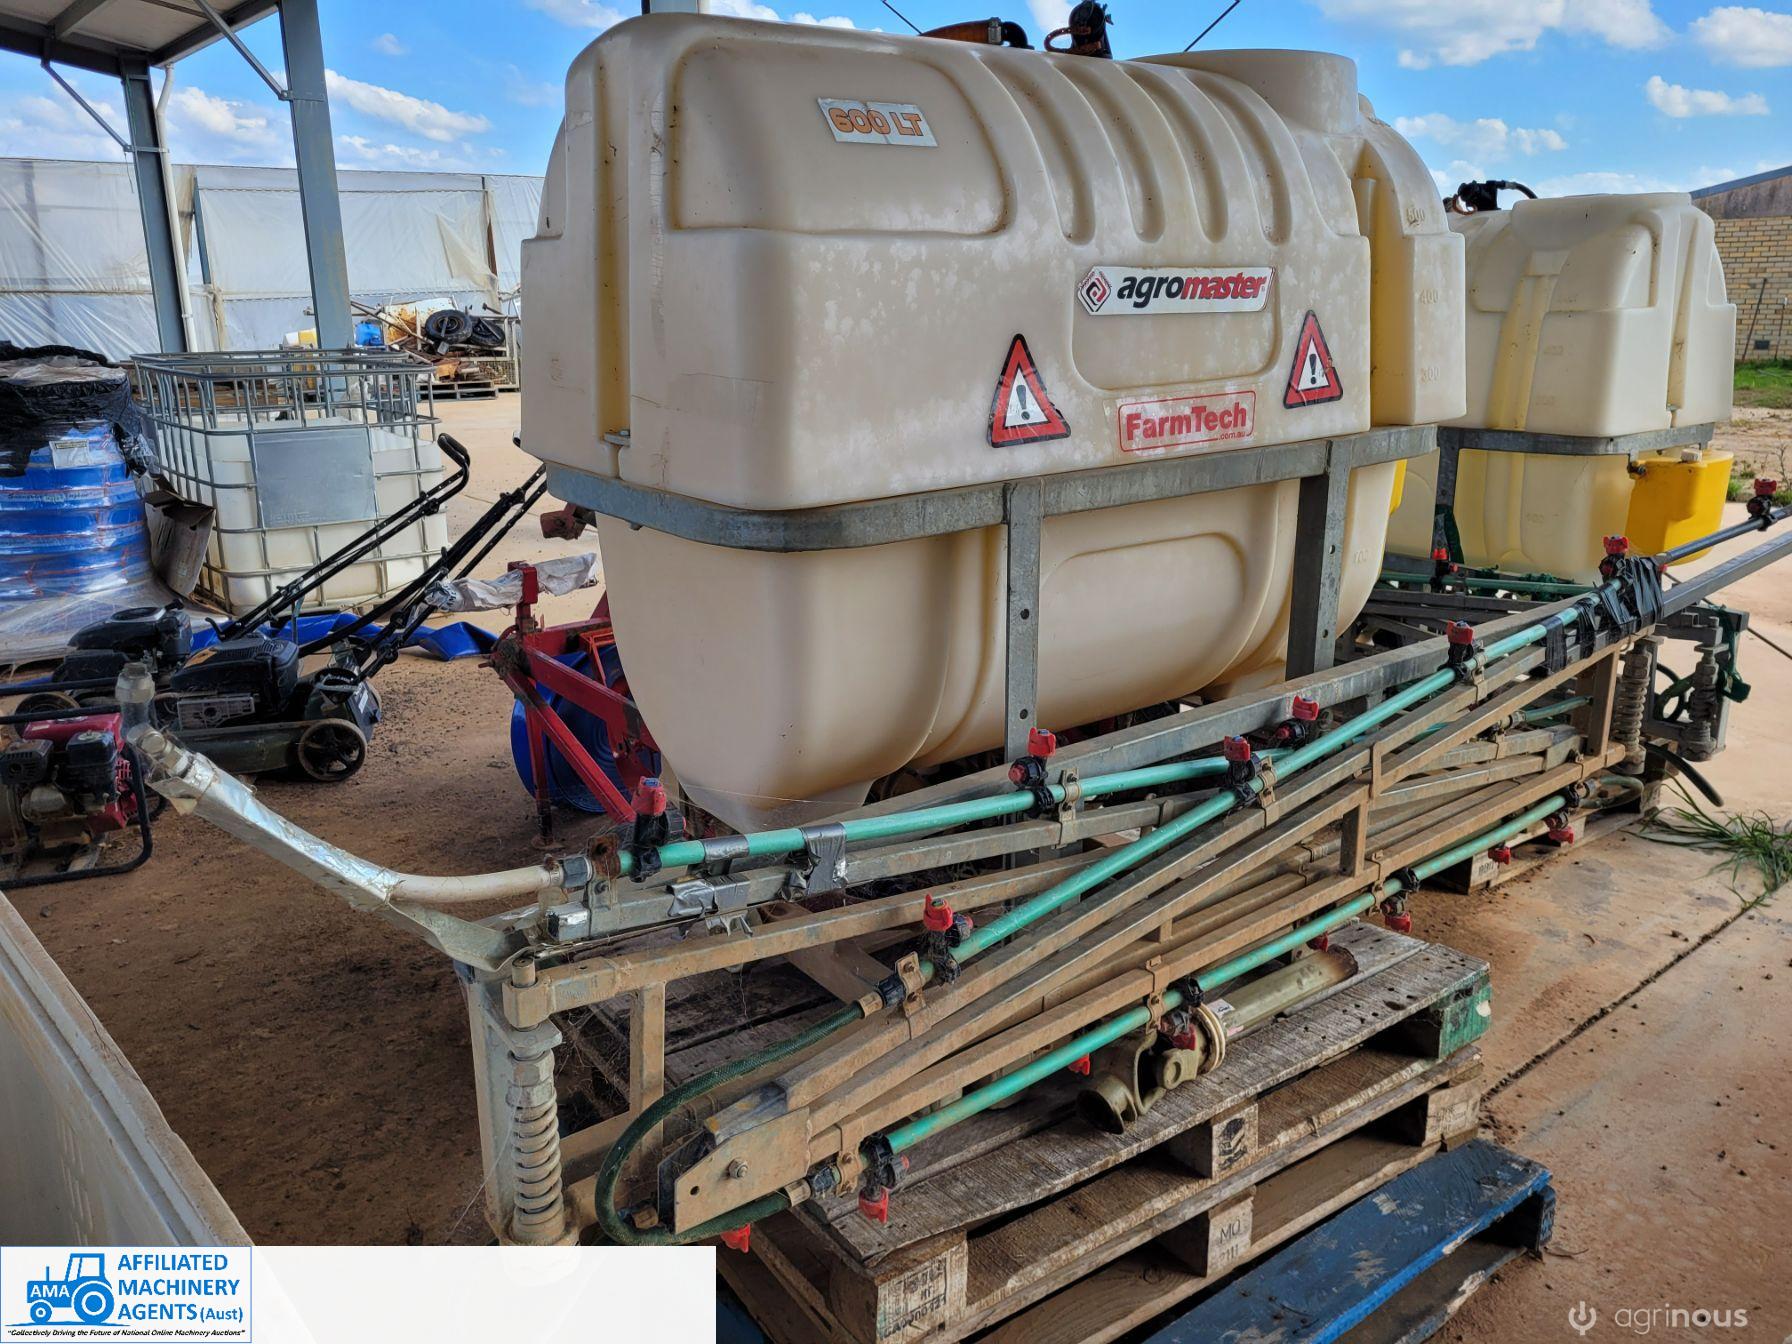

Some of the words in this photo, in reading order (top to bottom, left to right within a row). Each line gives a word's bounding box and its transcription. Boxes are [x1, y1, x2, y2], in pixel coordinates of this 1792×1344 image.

[828, 107, 891, 134] 600
[889, 111, 924, 136] LT
[1116, 272, 1267, 309] agromaster
[1125, 402, 1247, 441] FarmTech
